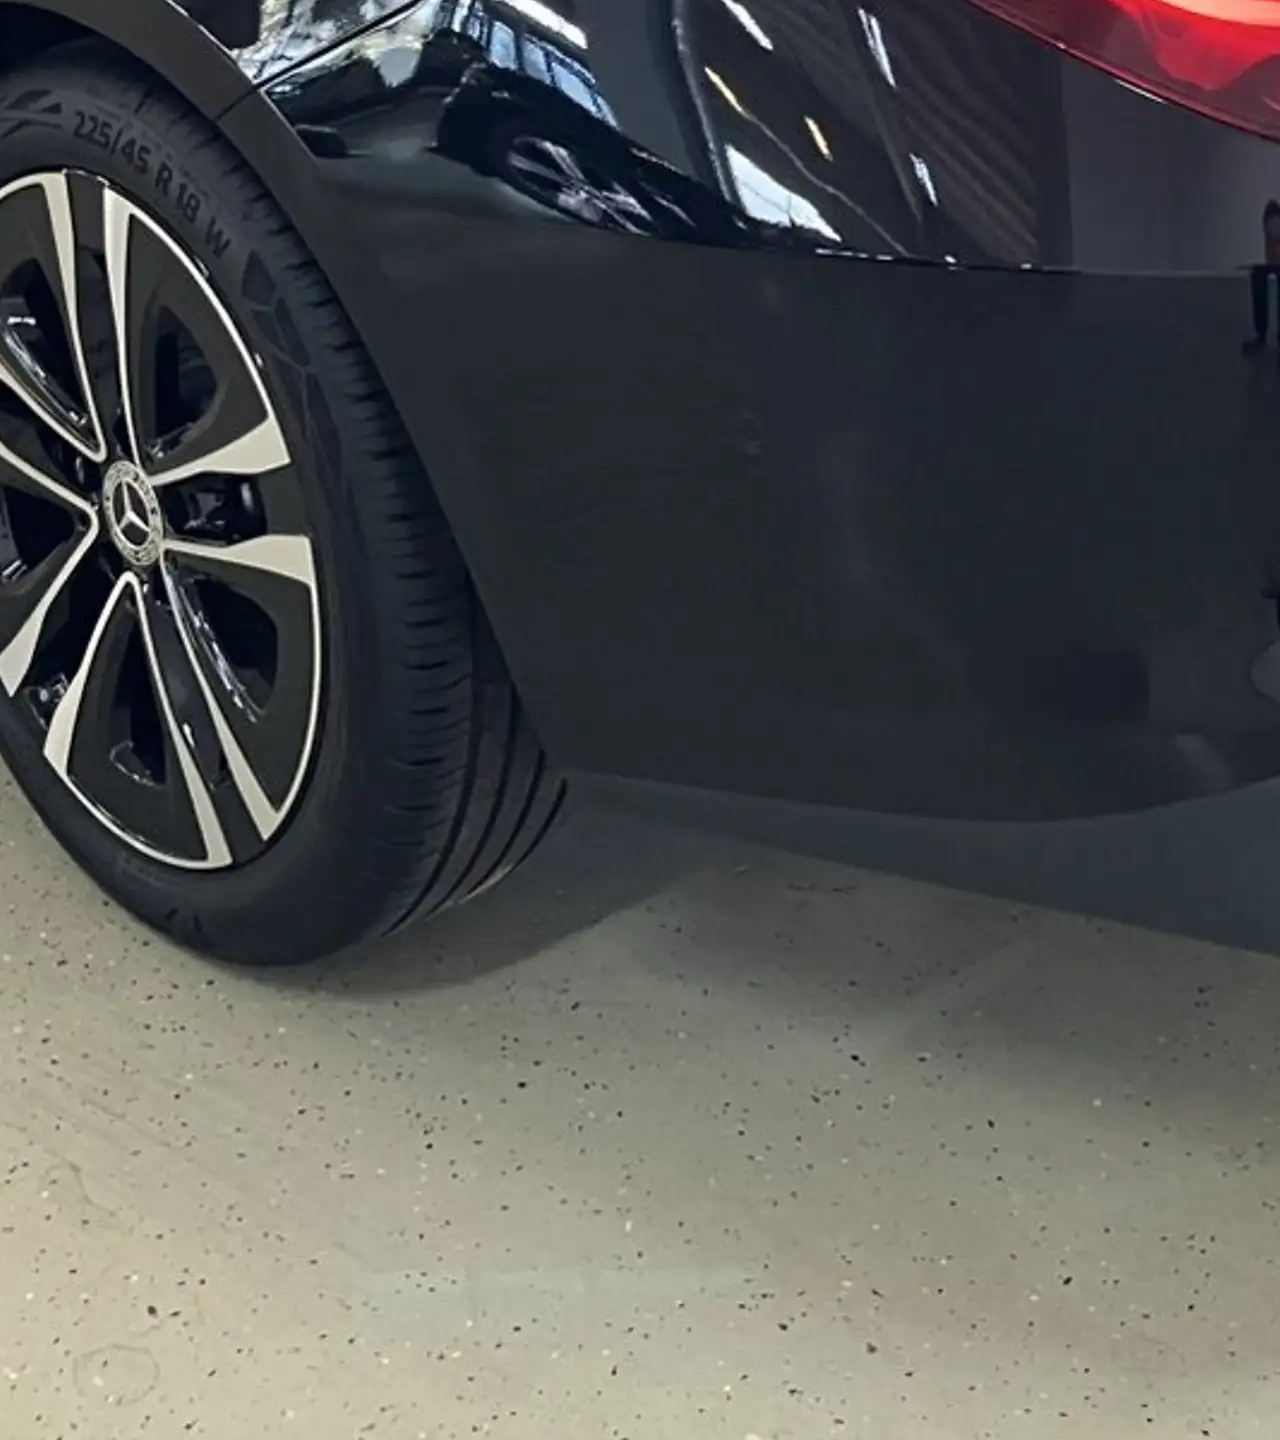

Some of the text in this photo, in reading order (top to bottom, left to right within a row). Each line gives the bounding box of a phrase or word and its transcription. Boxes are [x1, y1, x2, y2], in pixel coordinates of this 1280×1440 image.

[73, 111, 152, 174] 225/45
[154, 162, 174, 196] R
[175, 182, 202, 224] 18
